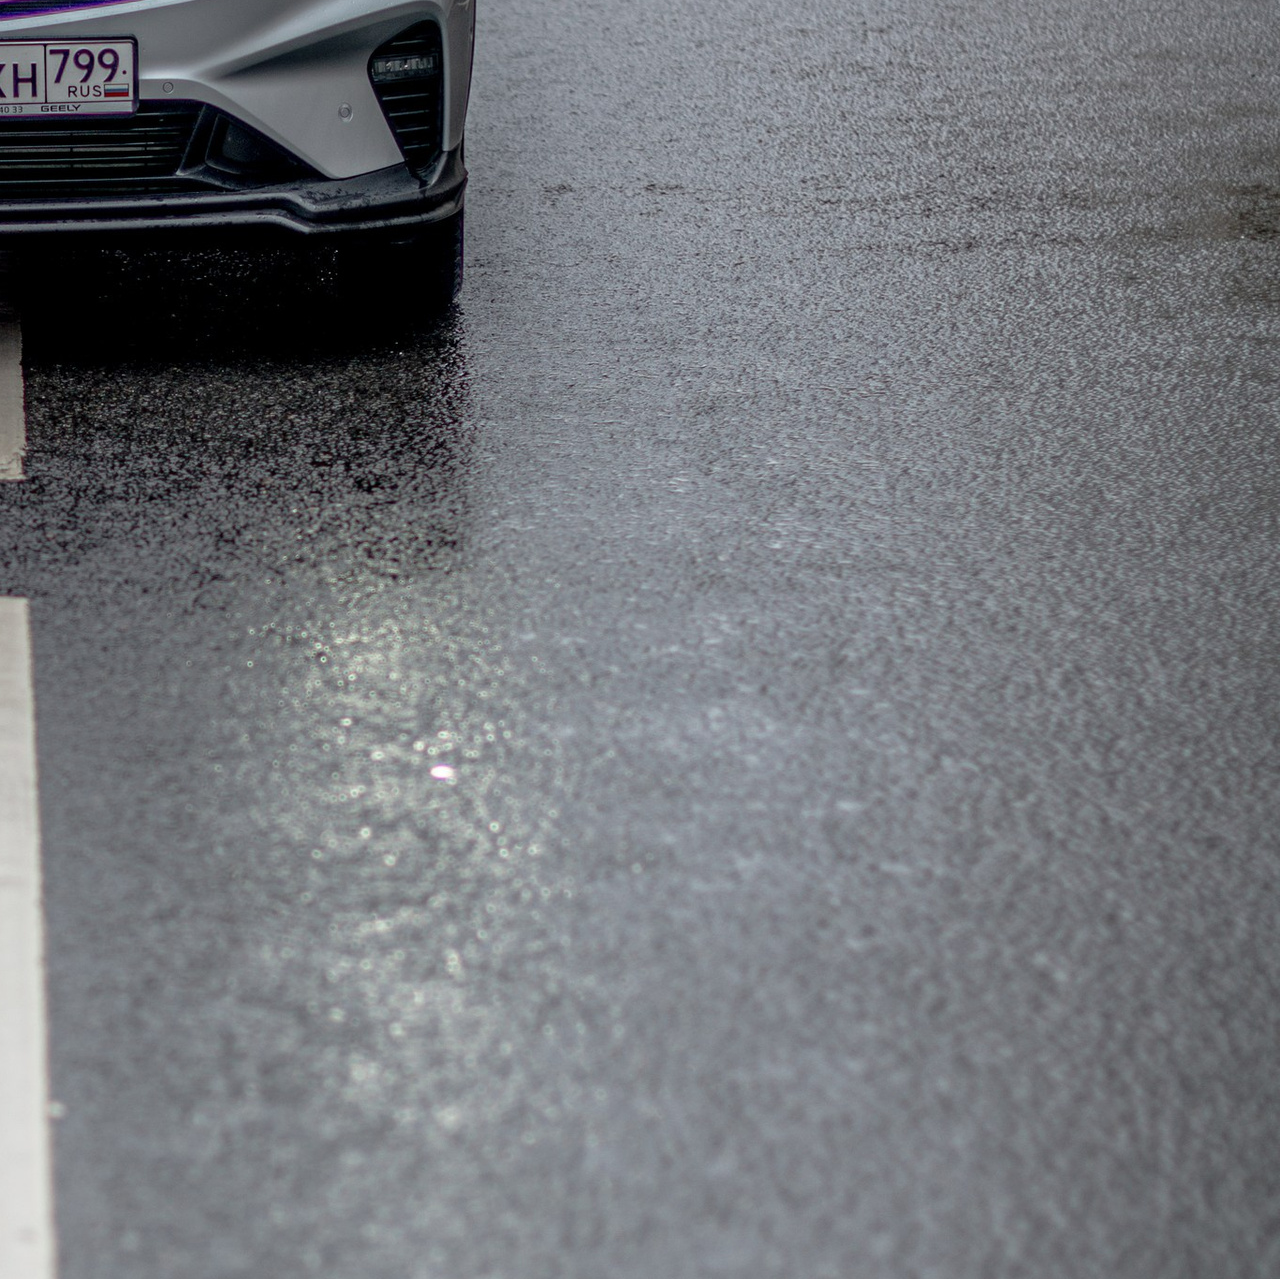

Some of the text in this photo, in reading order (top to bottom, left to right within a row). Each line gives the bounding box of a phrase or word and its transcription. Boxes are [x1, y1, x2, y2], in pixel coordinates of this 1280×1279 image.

[49, 48, 120, 84] 799
[67, 85, 102, 98] RUS
[40, 104, 81, 112] GEELY
